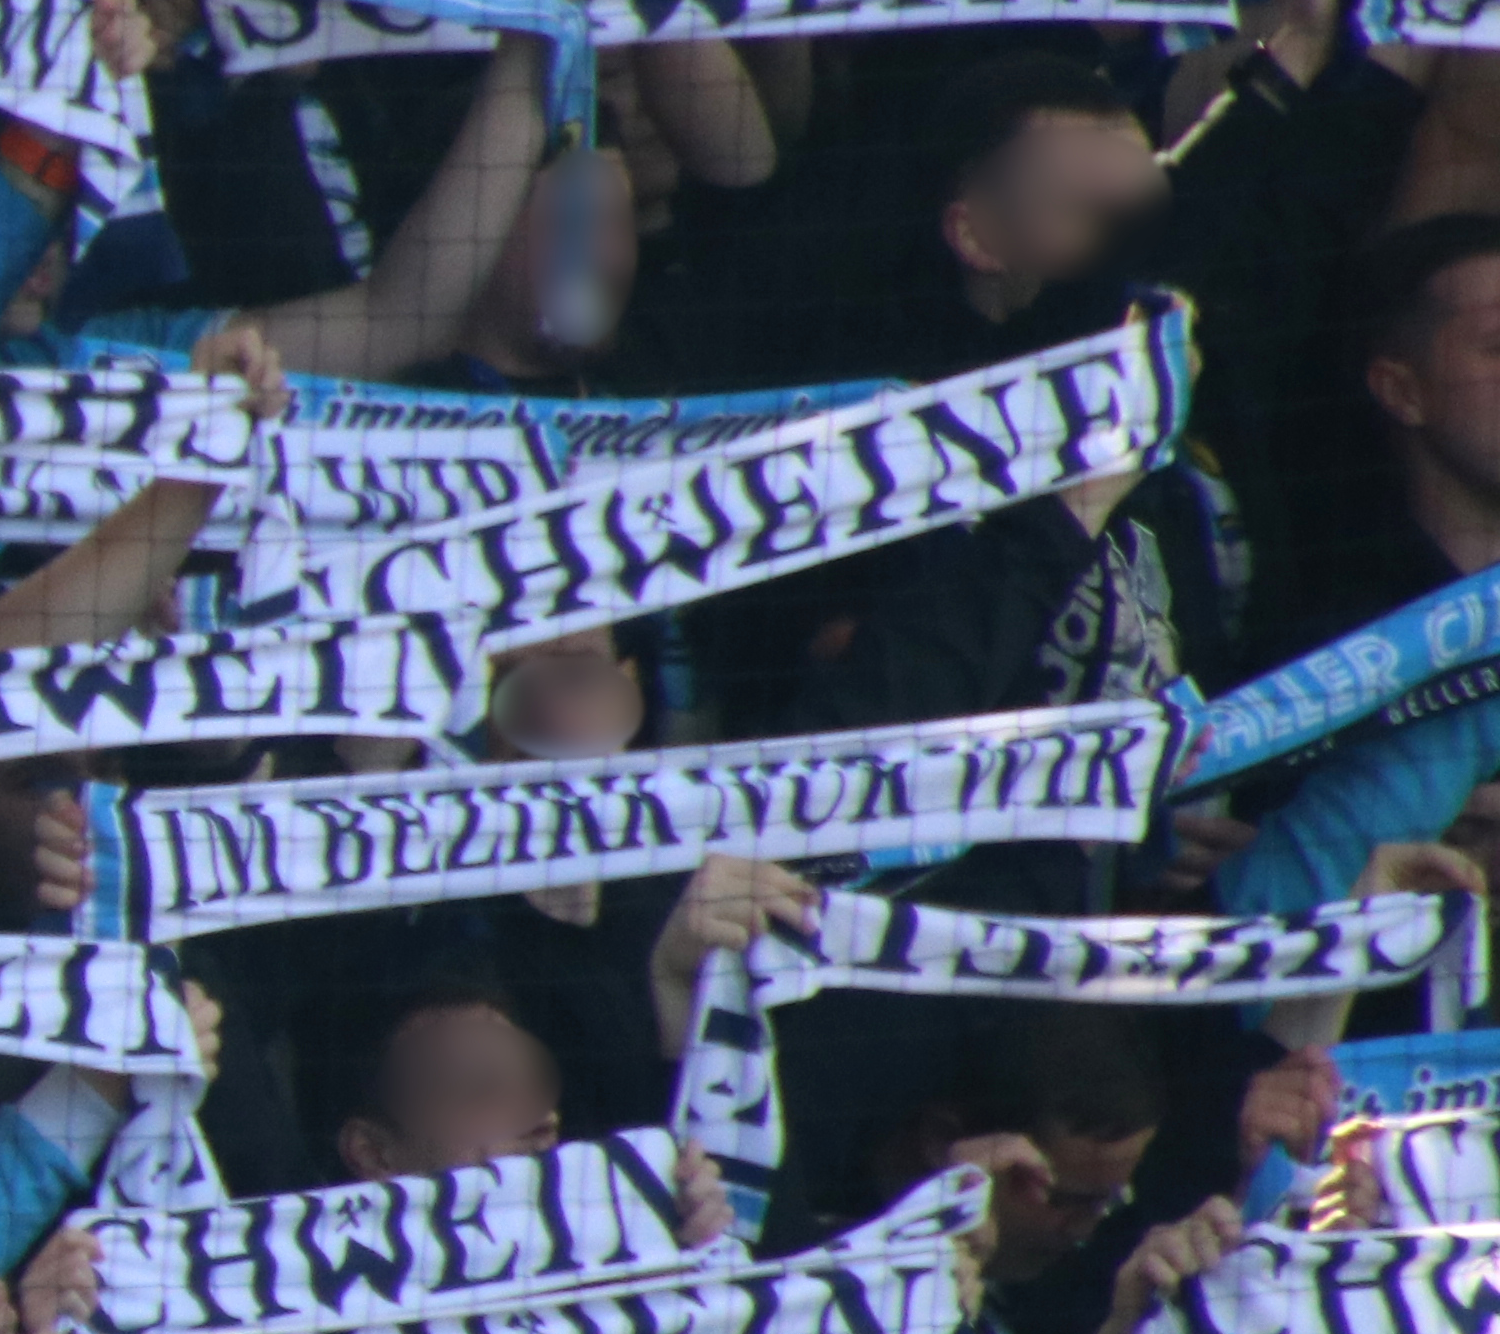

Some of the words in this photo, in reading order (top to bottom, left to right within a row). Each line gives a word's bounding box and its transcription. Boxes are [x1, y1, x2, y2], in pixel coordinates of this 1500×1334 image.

[240, 346, 1150, 629] CHWEINE
[151, 800, 282, 913] IM
[306, 772, 682, 888] BEZIRK
[707, 759, 909, 839] NUR
[956, 723, 1150, 814] WIR
